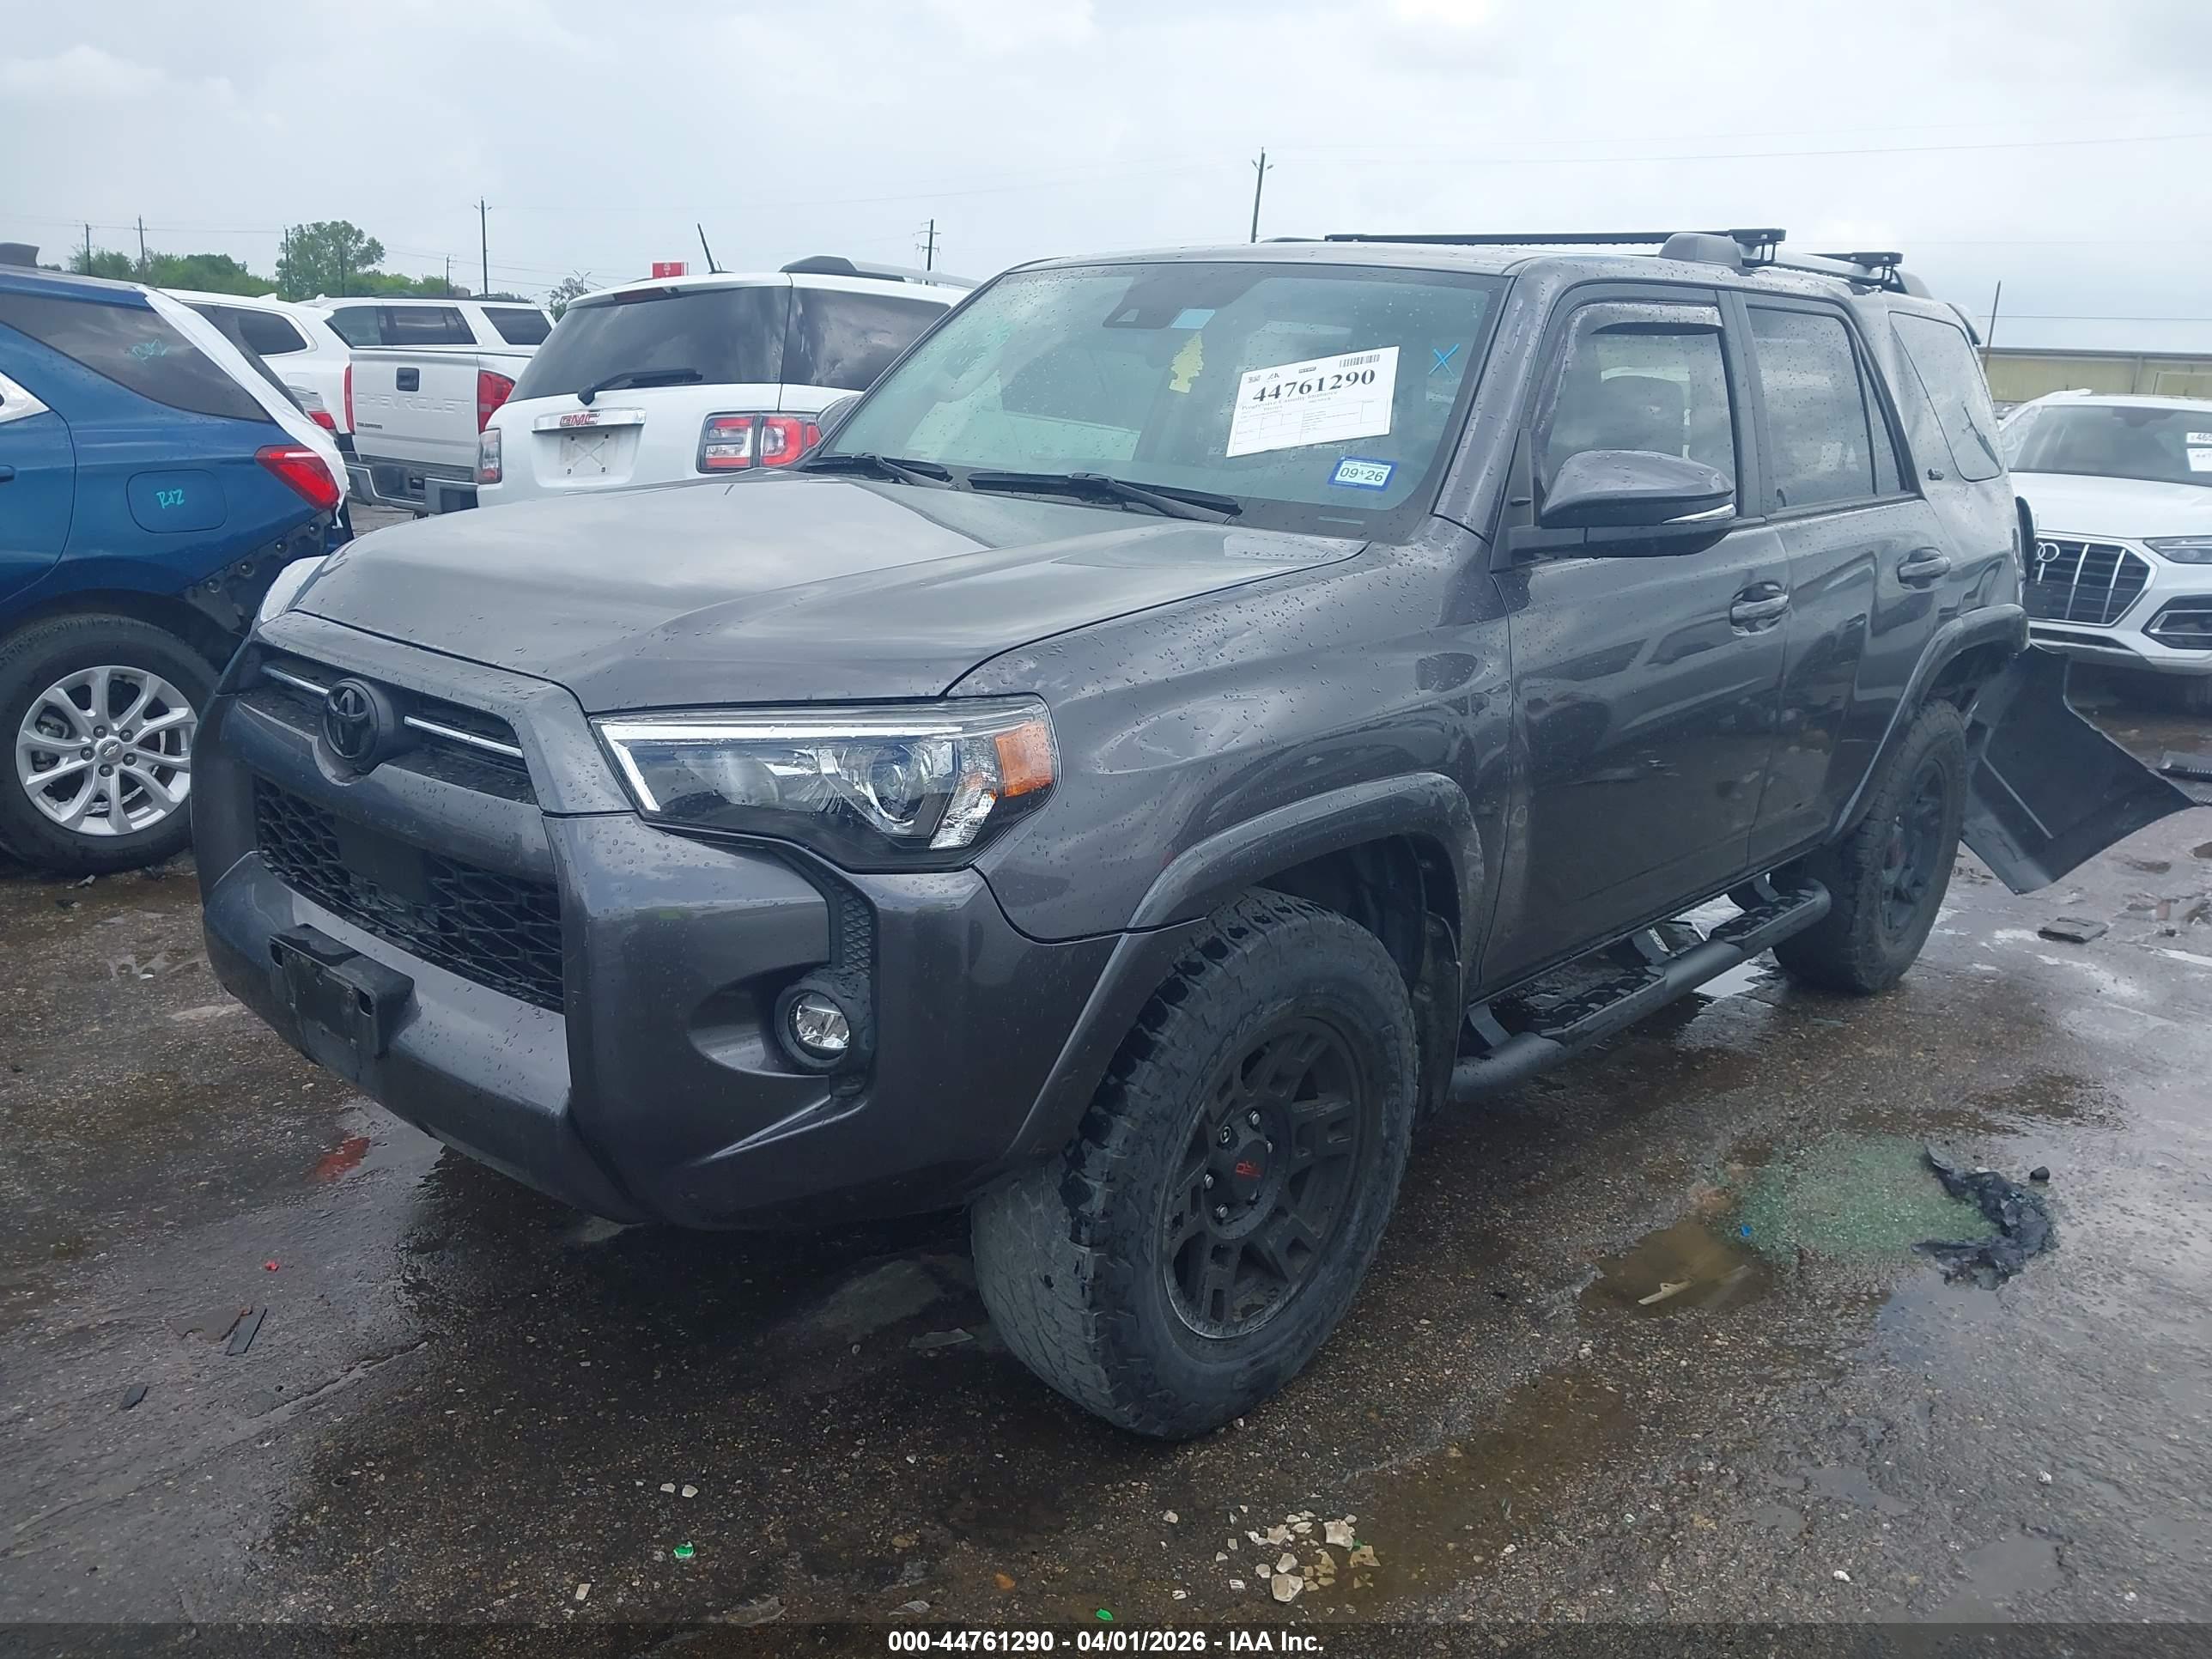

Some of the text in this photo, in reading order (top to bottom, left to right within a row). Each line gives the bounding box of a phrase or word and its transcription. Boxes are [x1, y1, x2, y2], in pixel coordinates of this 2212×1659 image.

[1252, 368, 1376, 402] 44761290
[356, 392, 471, 415] CHEVROLET
[559, 412, 600, 428] GMC
